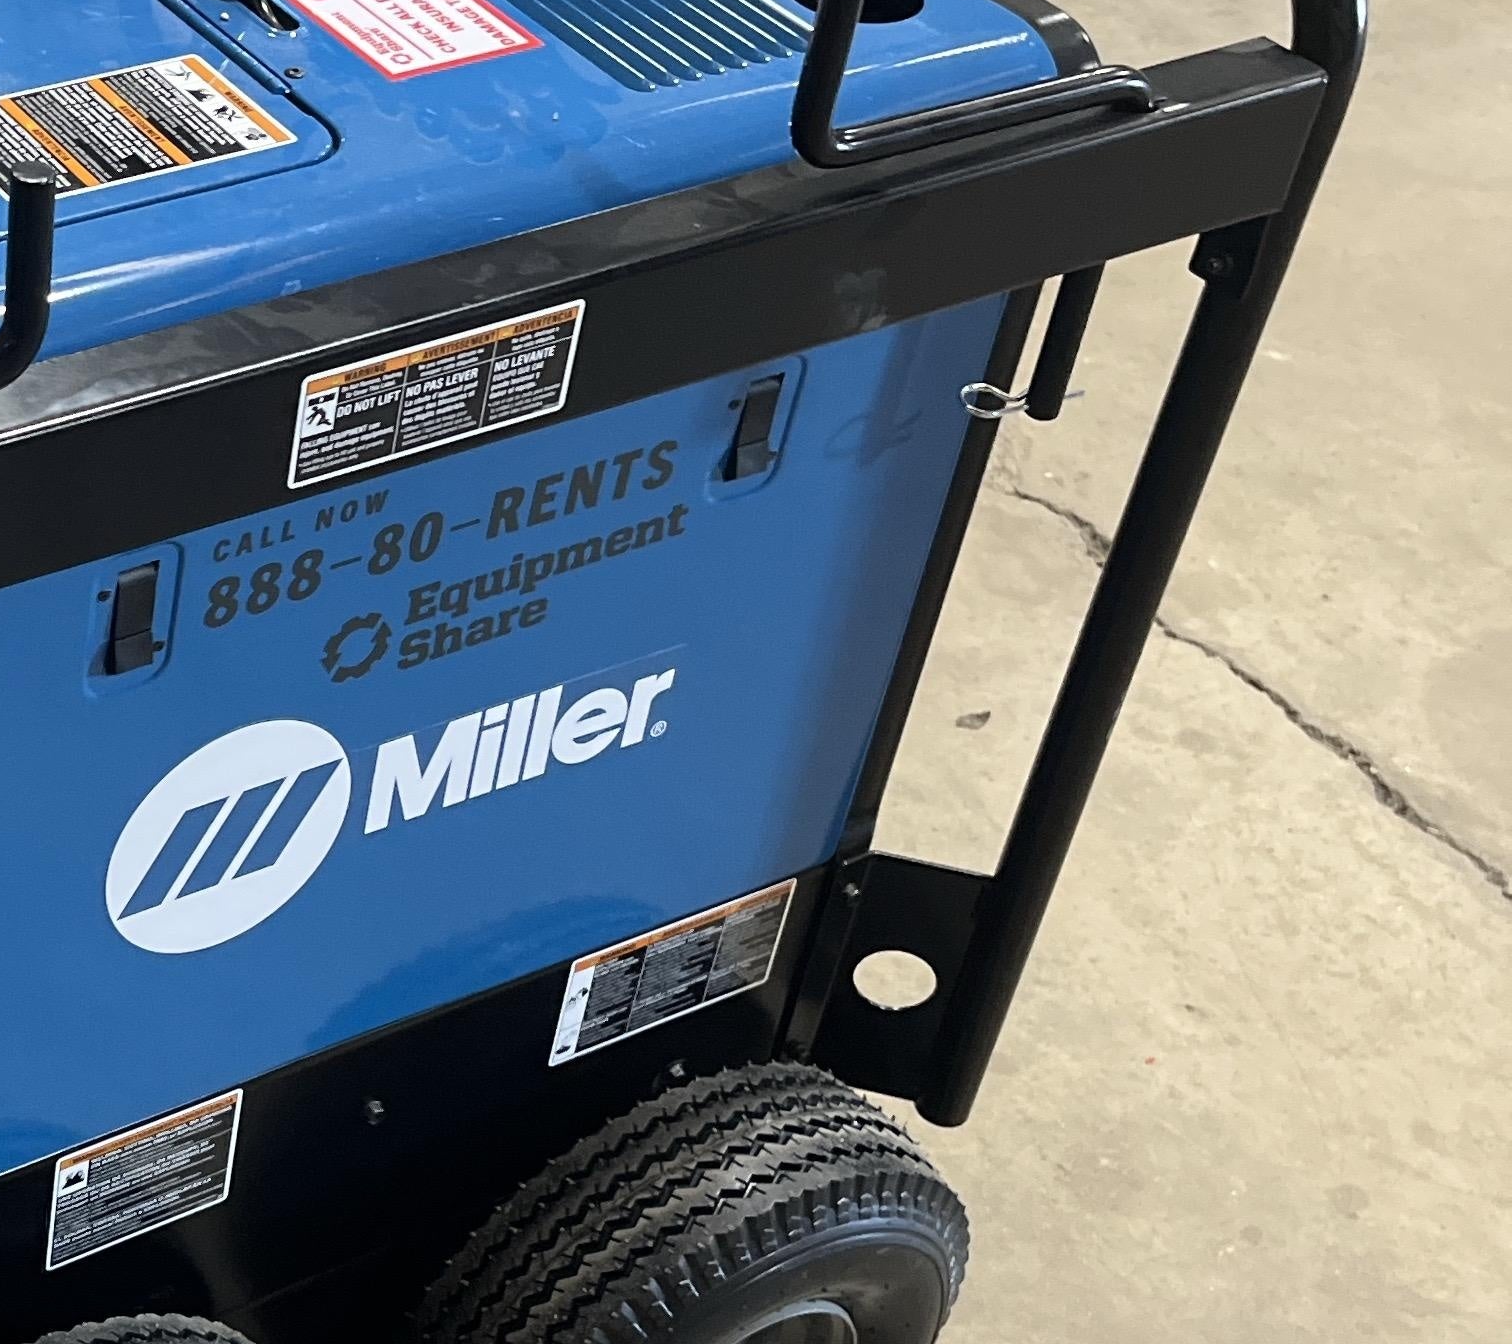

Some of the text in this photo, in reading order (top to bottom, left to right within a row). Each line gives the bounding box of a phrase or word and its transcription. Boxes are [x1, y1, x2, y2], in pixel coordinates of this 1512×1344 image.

[383, 3, 415, 20] ALL
[455, 6, 518, 46] DAMAGE
[406, 20, 459, 53] CHECK
[494, 358, 510, 373] NO
[510, 345, 557, 368] LEVANTE
[423, 376, 444, 393] PAS
[445, 367, 479, 388] LEVER
[336, 390, 401, 419] DO NOT LIFT
[213, 489, 389, 563] CALL NOW
[404, 503, 689, 626] Equipment
[397, 597, 548, 671] Share
